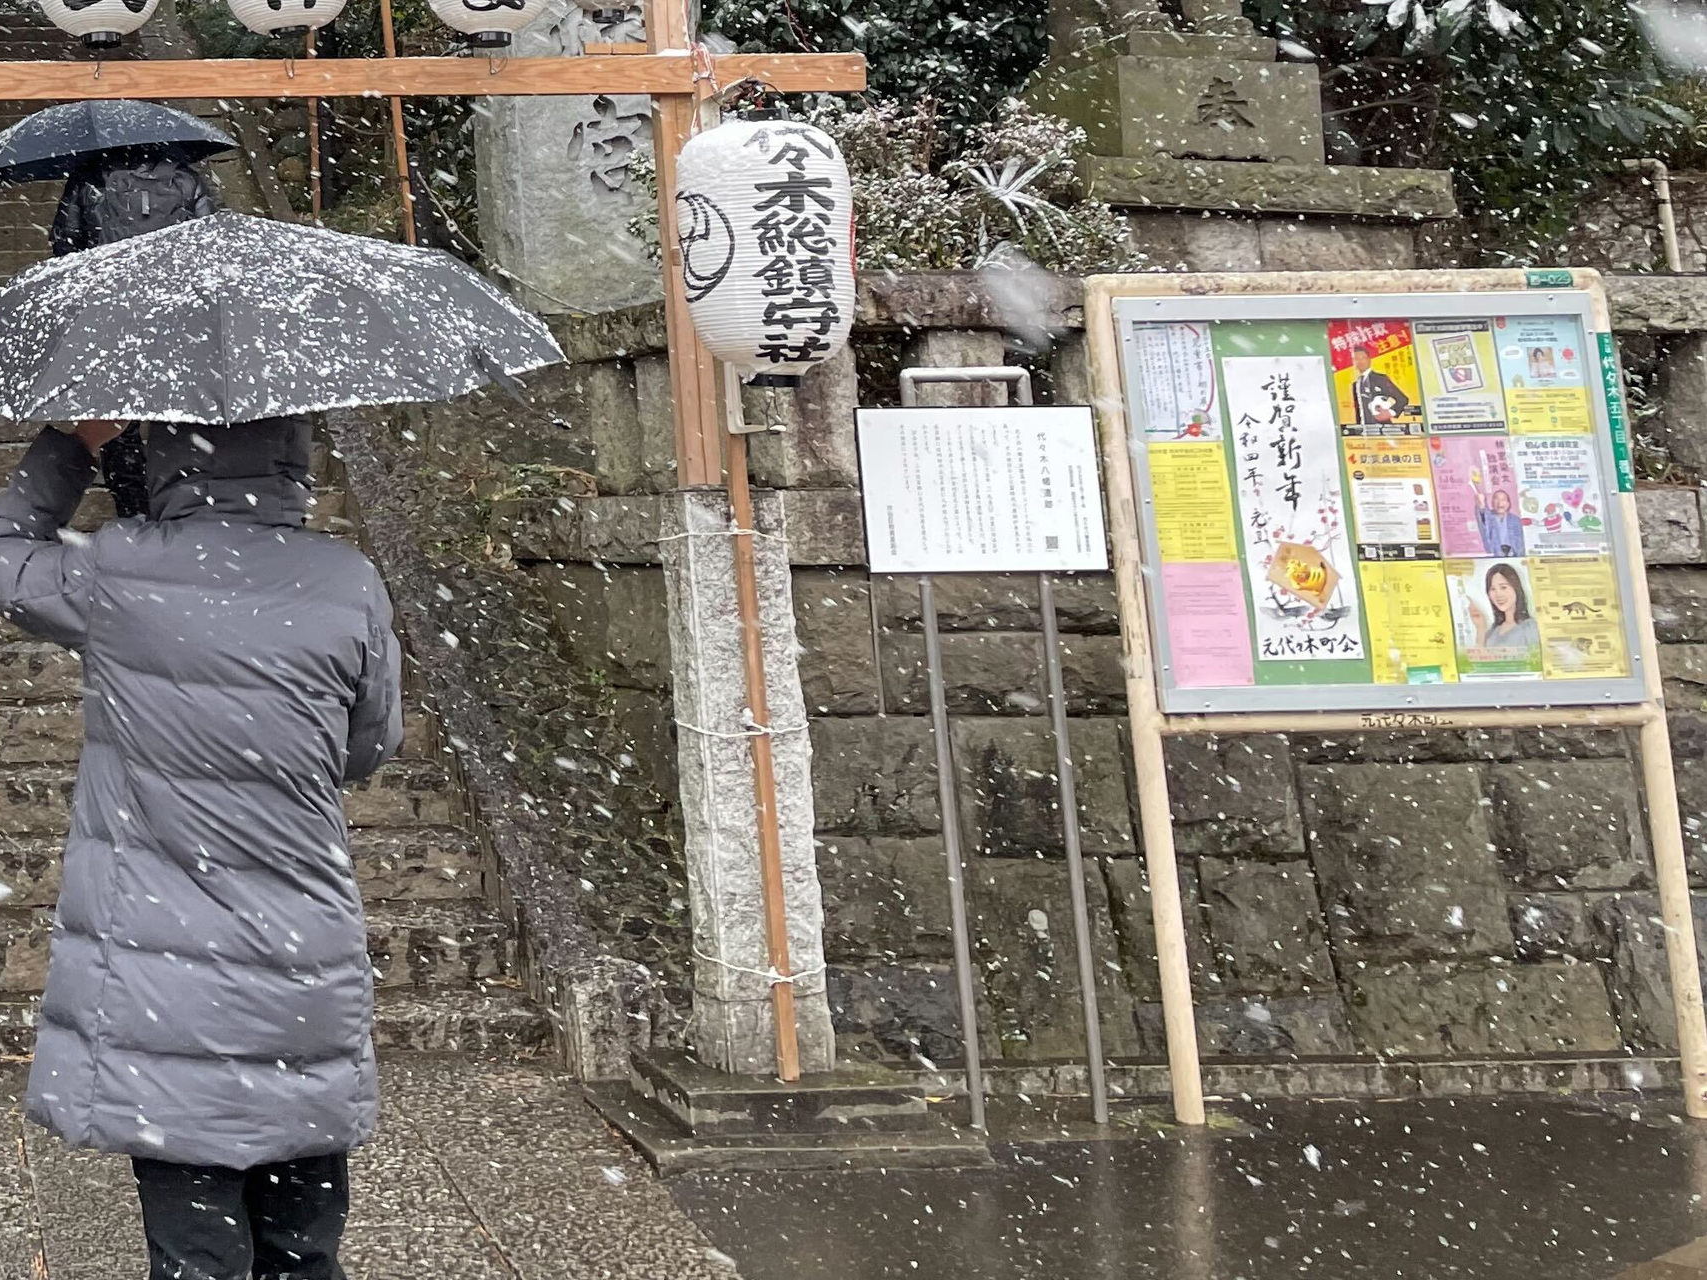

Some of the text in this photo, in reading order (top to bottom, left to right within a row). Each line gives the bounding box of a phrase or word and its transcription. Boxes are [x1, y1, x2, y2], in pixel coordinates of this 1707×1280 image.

[1196, 76, 1255, 128] 奉
[1037, 432, 1054, 509] 代々木八幡遺跡
[1237, 413, 1264, 488] 令和四年
[1261, 373, 1303, 512] 謹賀新年
